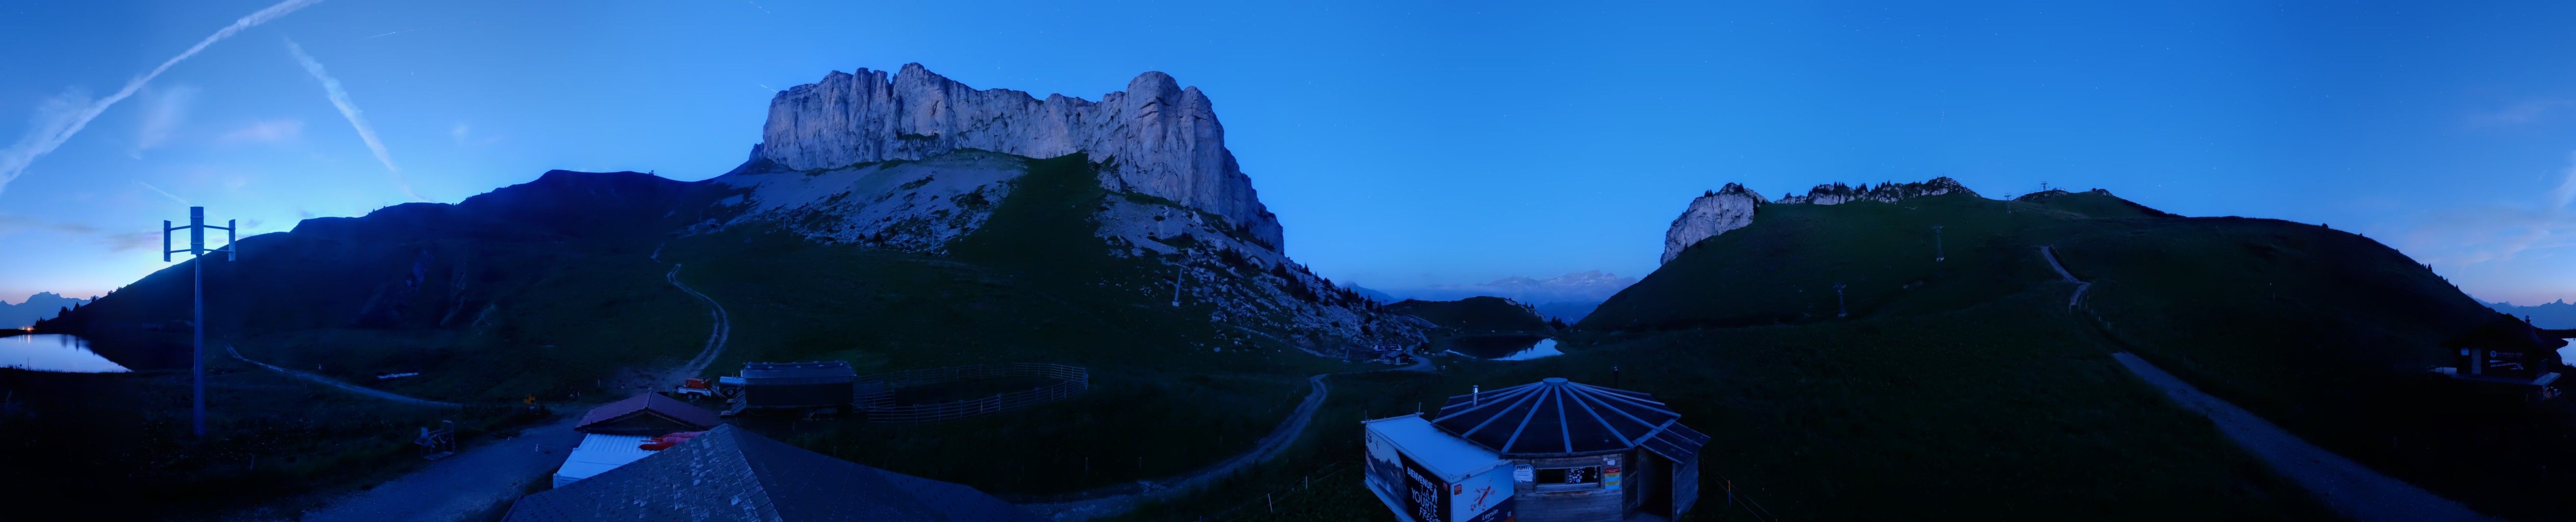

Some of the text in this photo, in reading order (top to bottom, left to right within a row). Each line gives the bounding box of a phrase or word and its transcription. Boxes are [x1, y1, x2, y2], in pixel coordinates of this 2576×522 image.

[1407, 466, 1433, 492] BIENVENUE
[1411, 487, 1437, 518] YOURTE
[1421, 485, 1430, 500] LA
[1482, 509, 1498, 520] Leysin
